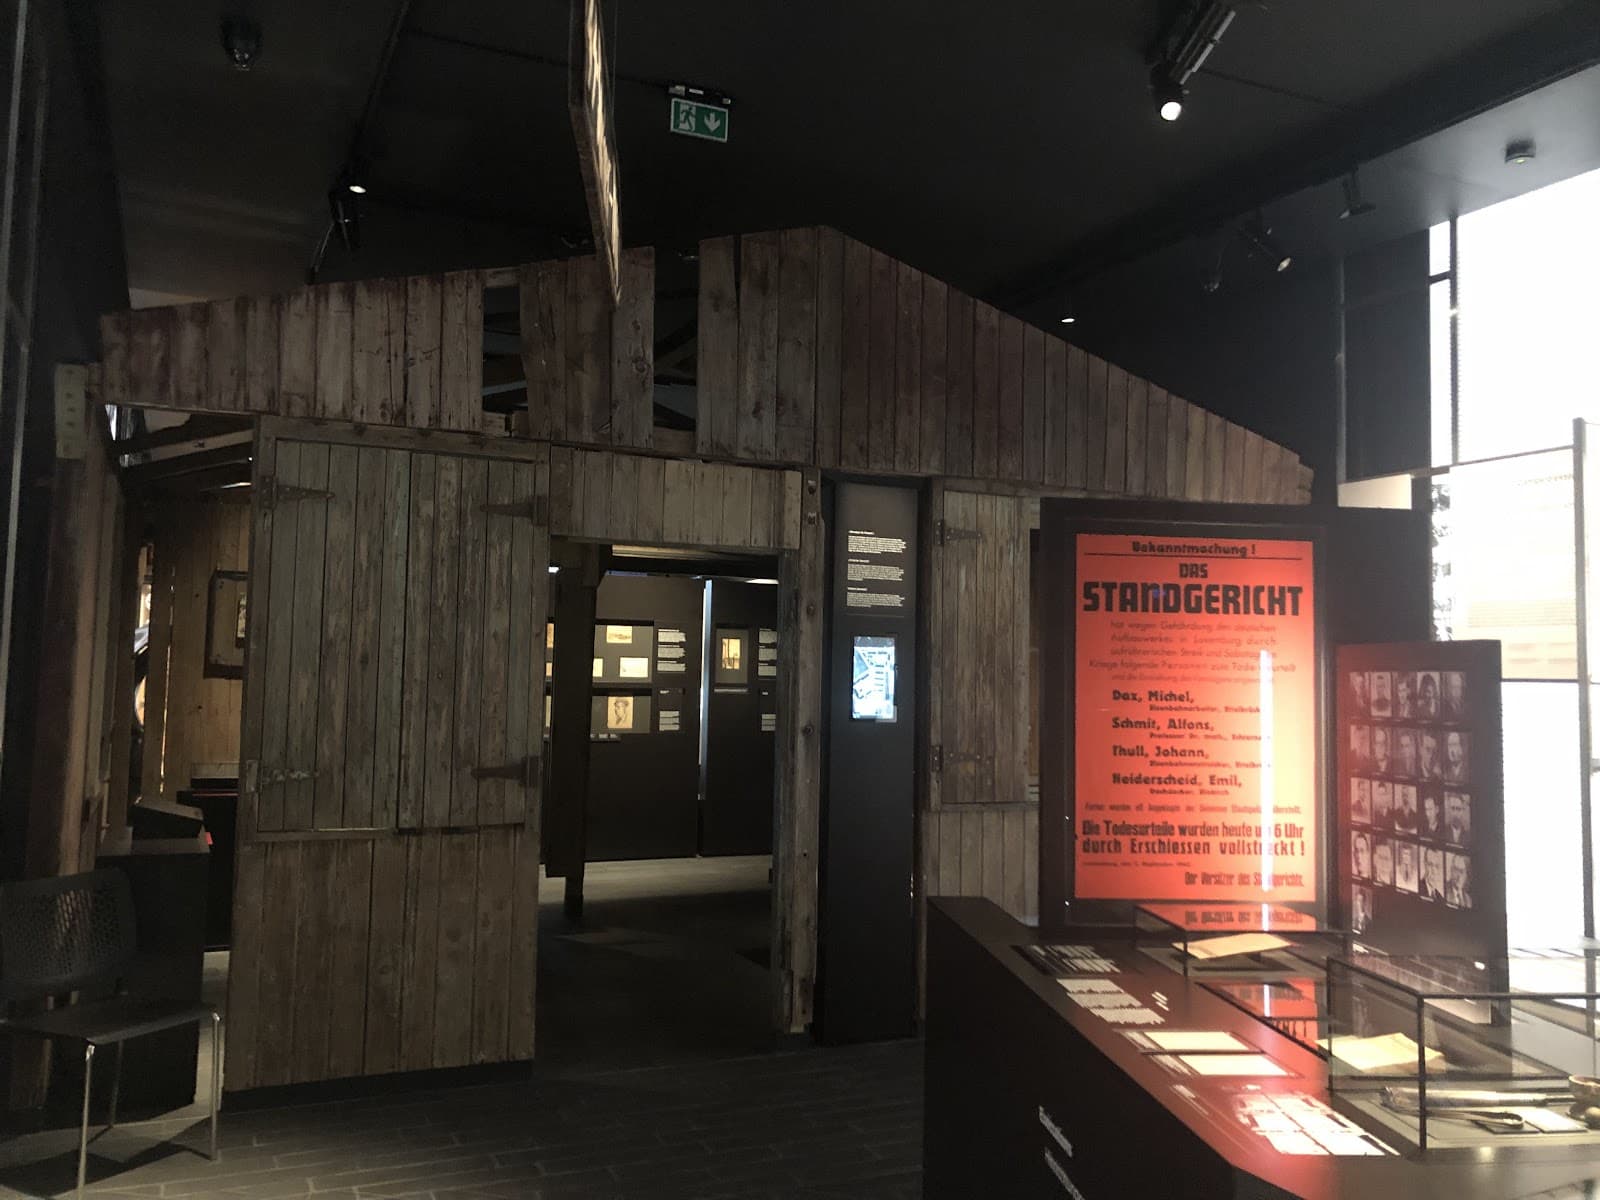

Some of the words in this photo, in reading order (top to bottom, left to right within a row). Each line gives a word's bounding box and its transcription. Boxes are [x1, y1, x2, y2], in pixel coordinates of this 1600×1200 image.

[1132, 541, 1247, 558] Bekanntmachung
[1179, 563, 1208, 579] DAS
[1083, 581, 1303, 616] STANDGERICHT
[1112, 690, 1142, 702] Dax,
[1148, 690, 1194, 703] Michel,
[1112, 717, 1160, 730] Schmit,
[1168, 718, 1214, 731] Alfons,
[1112, 745, 1149, 758] Thull,
[1155, 746, 1209, 759] Johann,
[1209, 775, 1242, 787] Emil,
[1104, 820, 1175, 836] Todesurteile
[1178, 821, 1219, 837] wurden
[1222, 821, 1252, 838] heute
[1274, 823, 1282, 838] 6
[1284, 823, 1304, 838] Uhr
[1082, 839, 1121, 854] durch
[1130, 839, 1210, 854] Erschiessen
